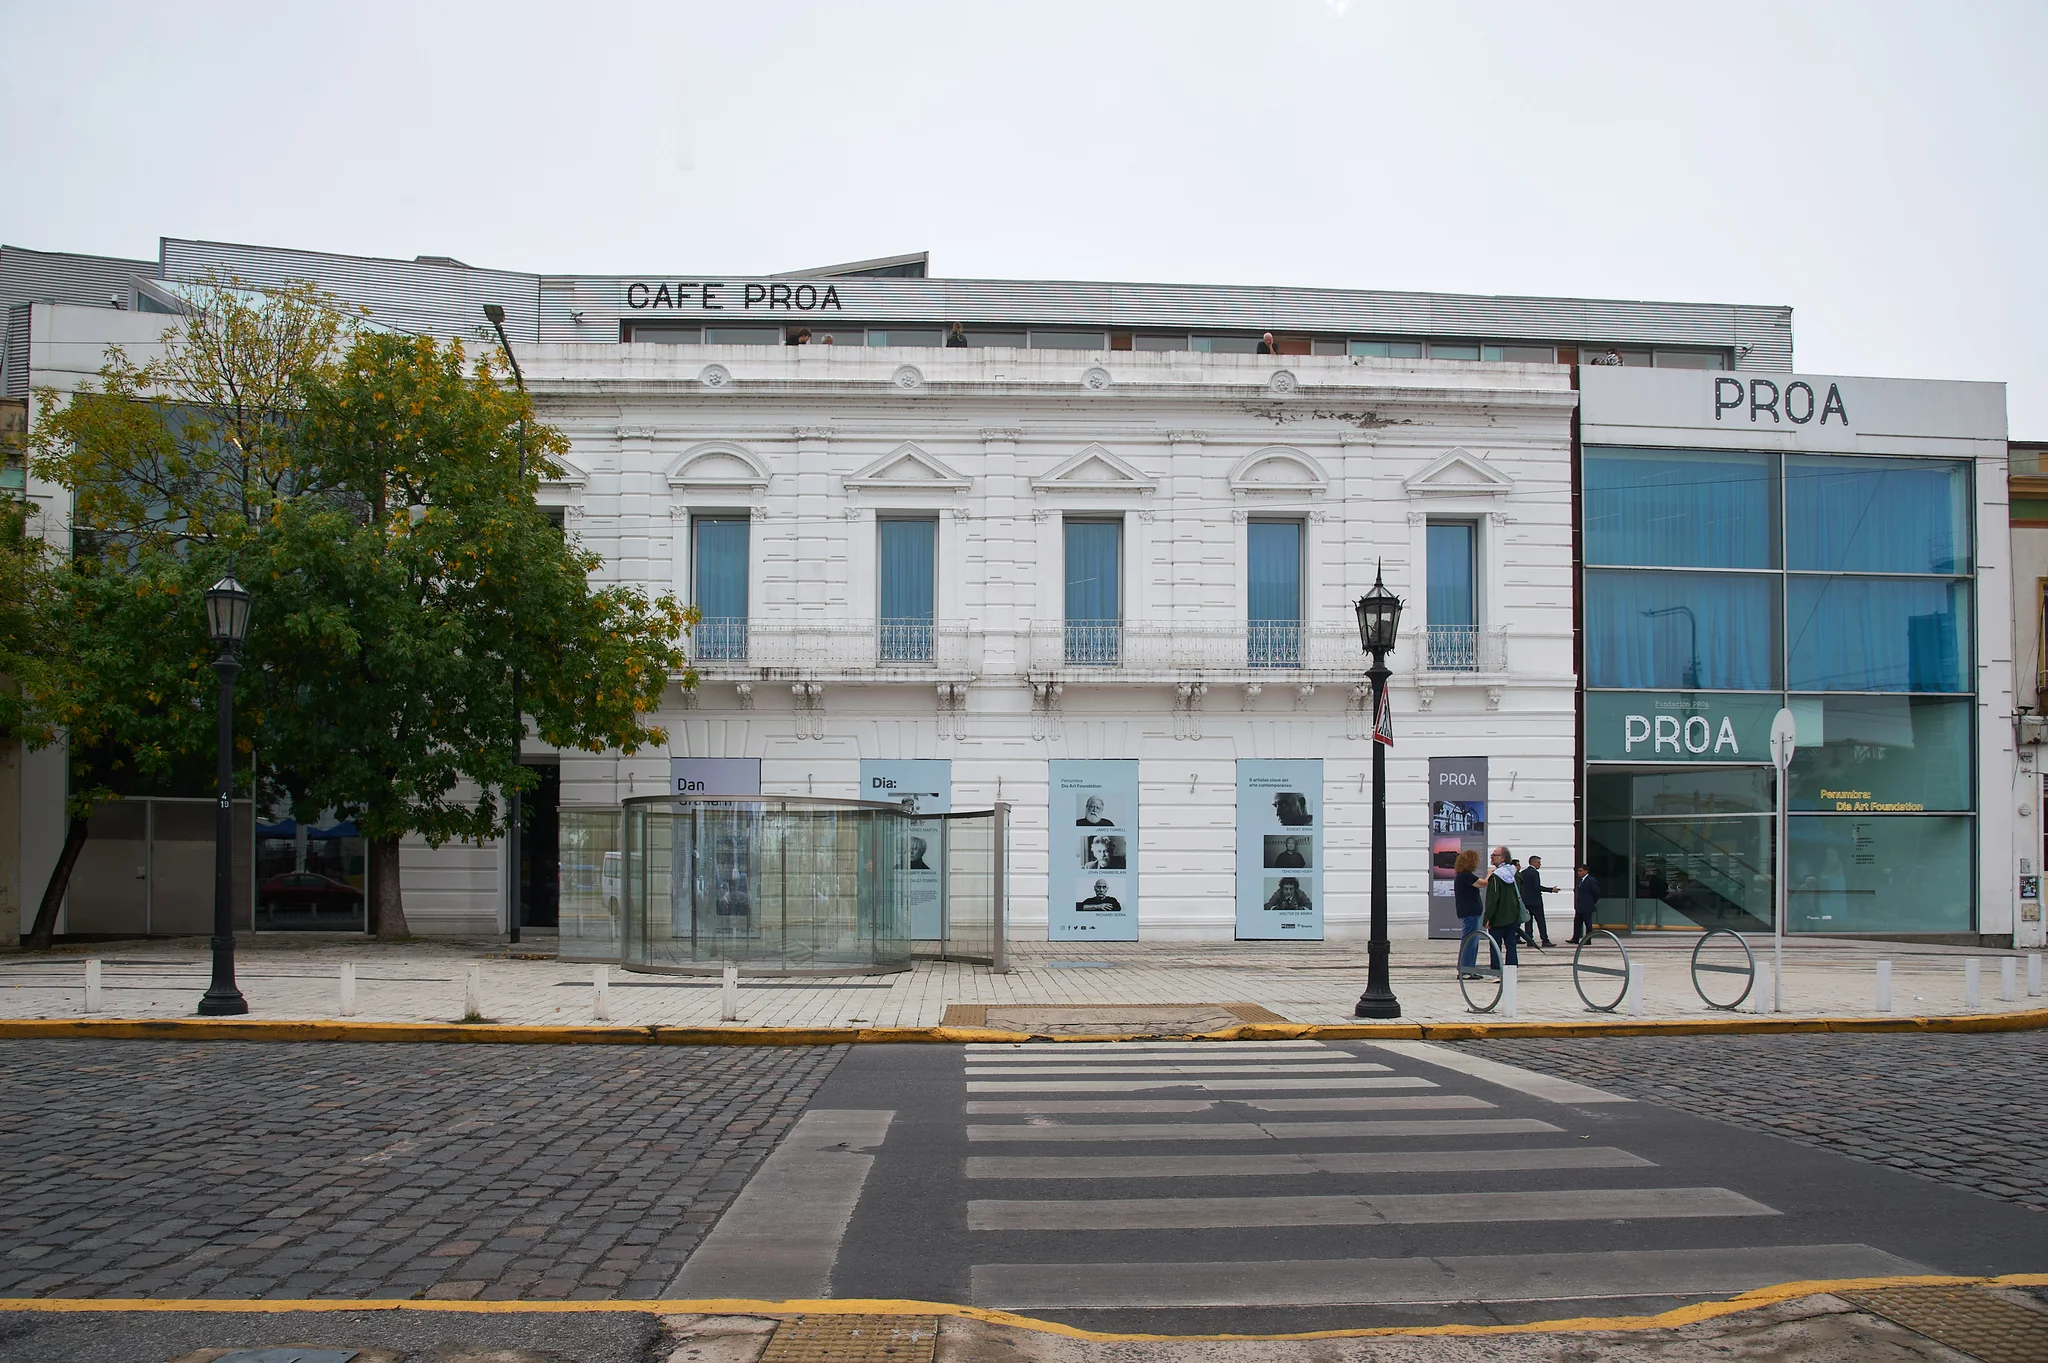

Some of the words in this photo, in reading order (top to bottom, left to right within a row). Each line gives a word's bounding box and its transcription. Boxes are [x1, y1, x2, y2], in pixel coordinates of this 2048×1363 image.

[627, 283, 724, 309] CAFE
[744, 283, 842, 310] PROA
[1715, 377, 1849, 426] PROA
[1654, 700, 1690, 708] Fundación
[1692, 700, 1710, 708] PROA
[1625, 715, 1739, 753] PROA
[677, 778, 705, 791] Dan
[872, 777, 897, 789] Dia:
[1439, 773, 1477, 786] PROA
[221, 792, 227, 800] 4
[1820, 789, 1872, 799] Penumbra:
[220, 800, 230, 808] 19
[1836, 801, 1852, 811] Dia
[1853, 801, 1869, 811] Art
[1870, 801, 1924, 811] Foundation
